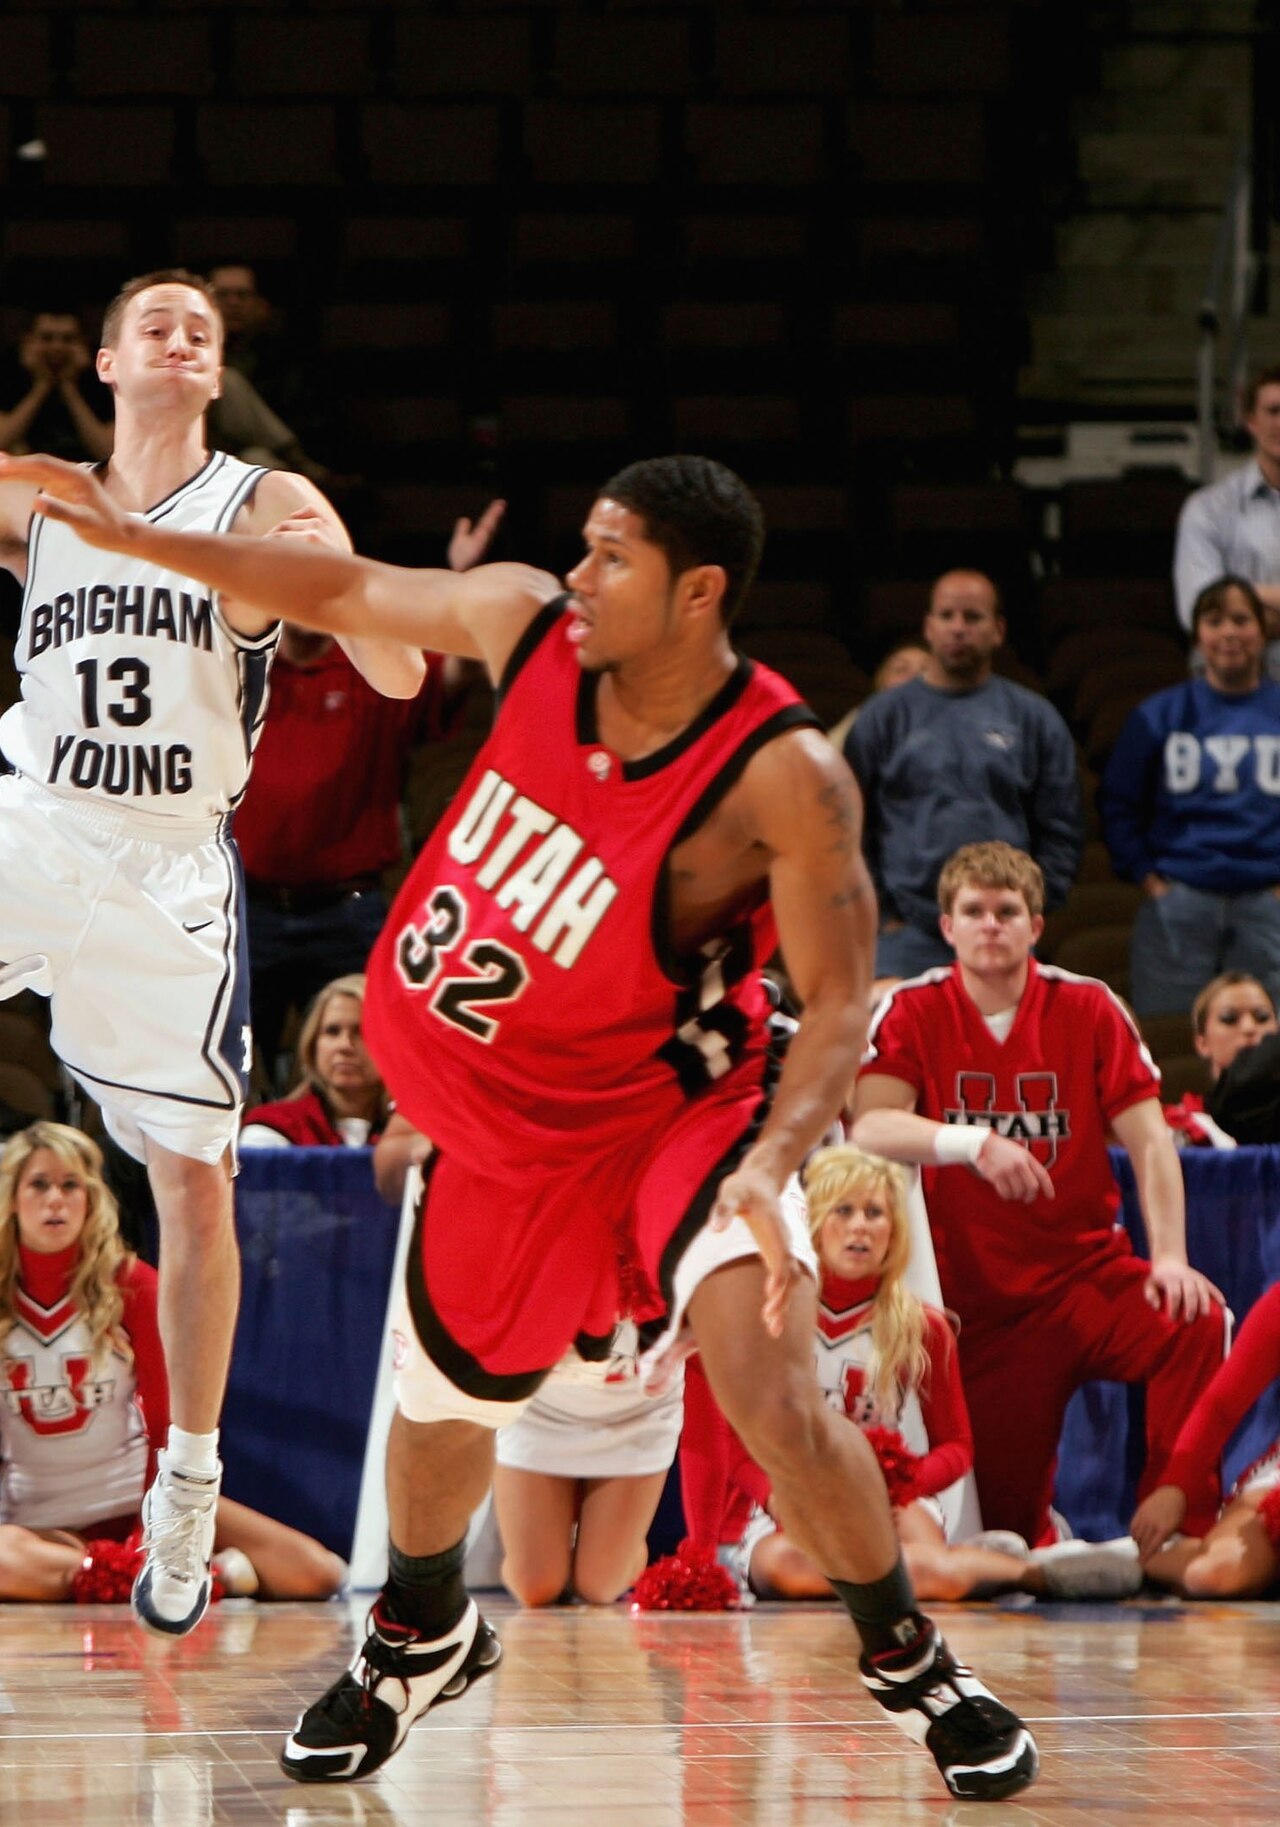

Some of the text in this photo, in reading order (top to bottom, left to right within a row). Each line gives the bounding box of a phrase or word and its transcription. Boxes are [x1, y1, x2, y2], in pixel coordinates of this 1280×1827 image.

[27, 584, 214, 661] BRIGHAM
[75, 657, 153, 729] 13
[47, 735, 193, 797] YOUNG
[1164, 731, 1280, 795] BYU
[447, 769, 618, 969] UTAH
[395, 884, 531, 1045] 32
